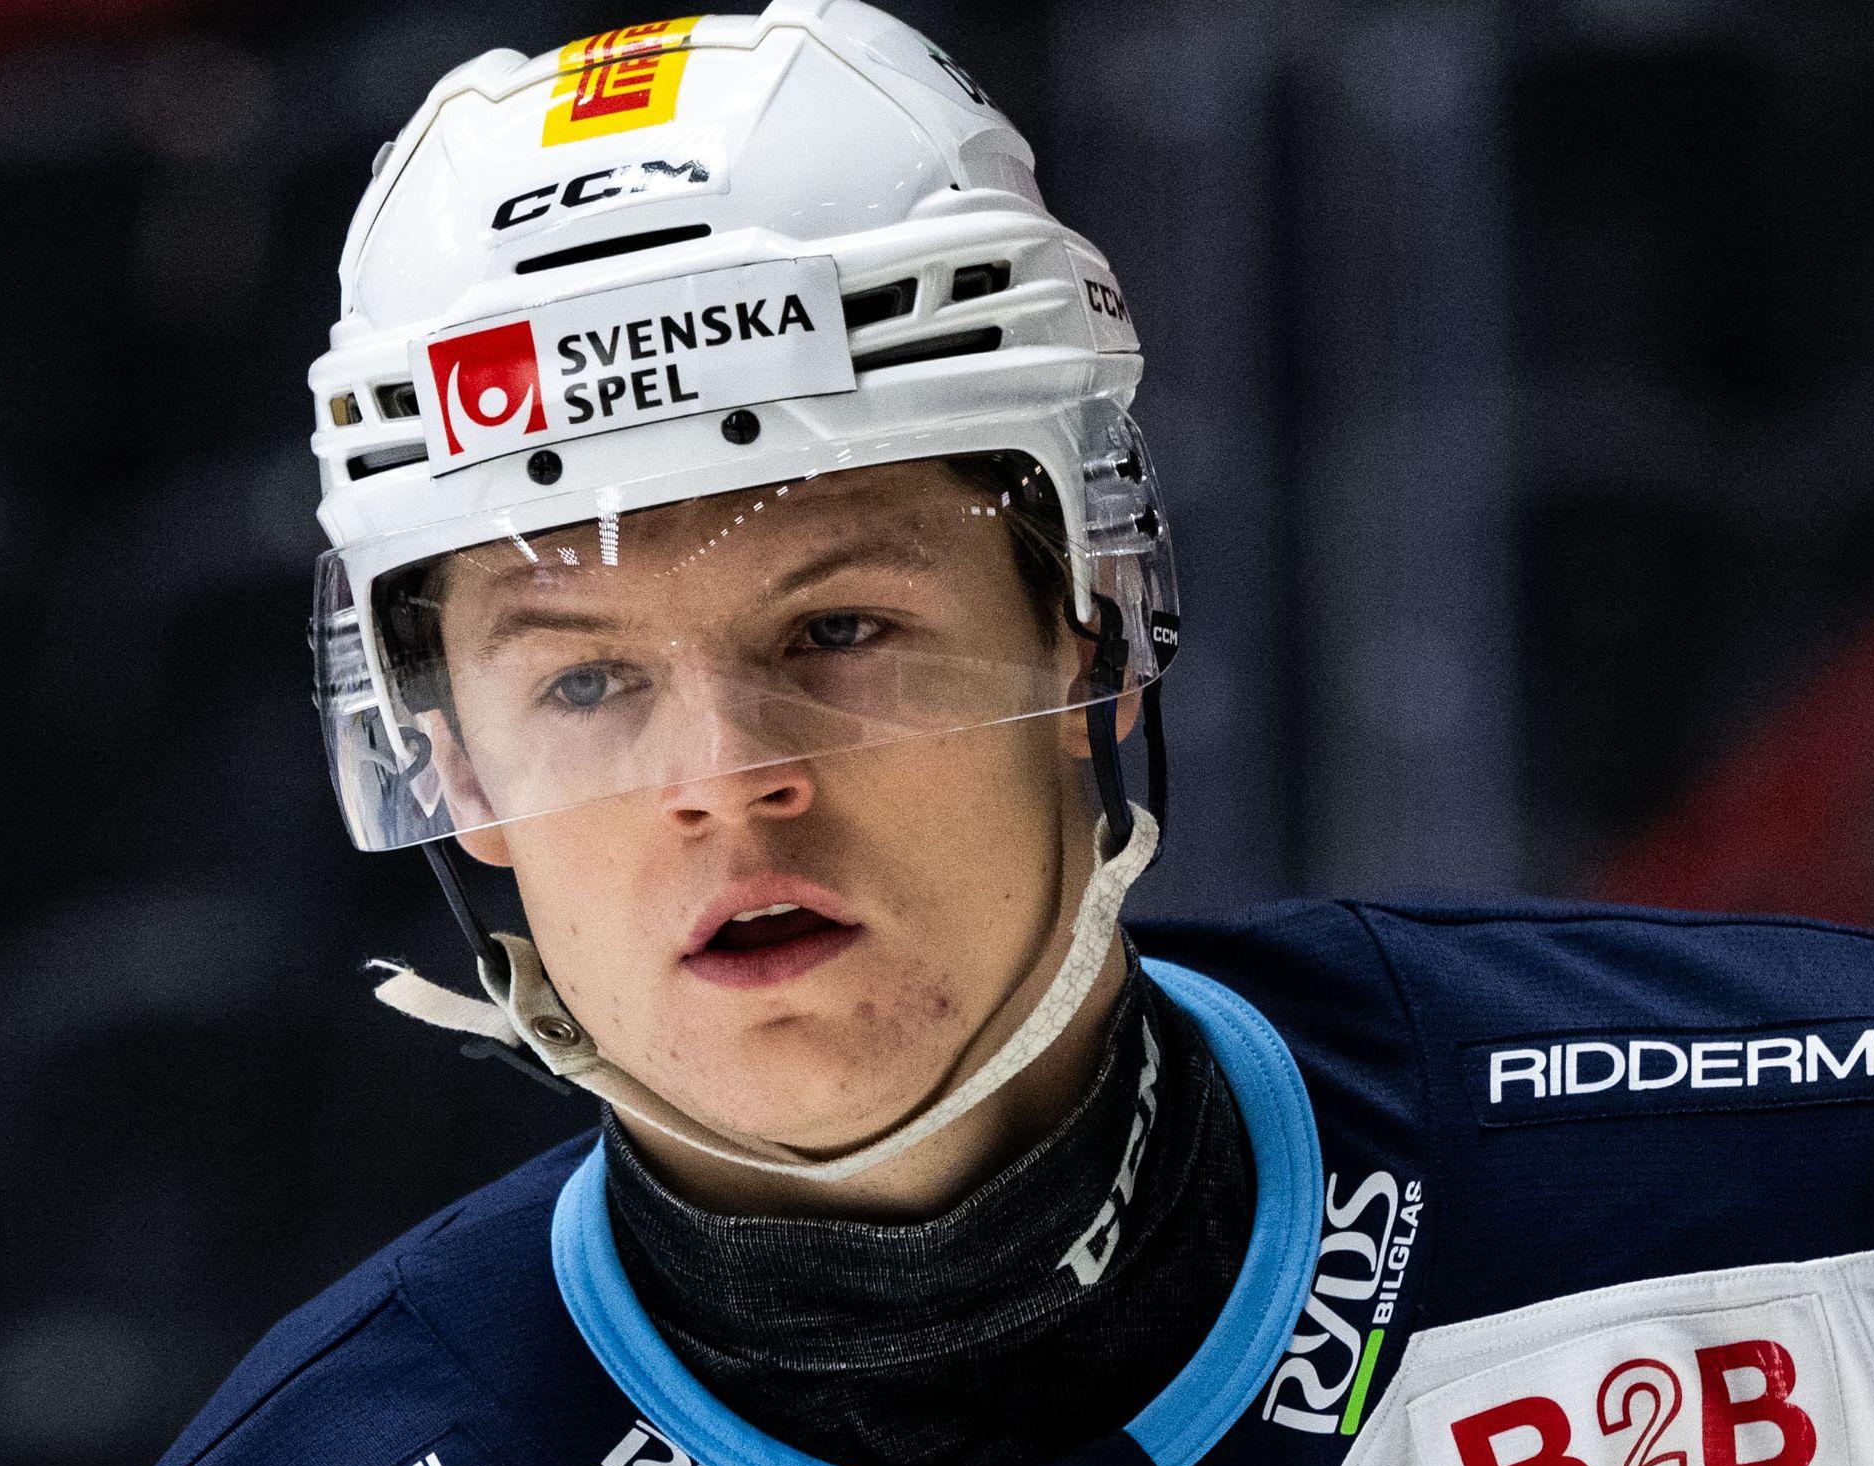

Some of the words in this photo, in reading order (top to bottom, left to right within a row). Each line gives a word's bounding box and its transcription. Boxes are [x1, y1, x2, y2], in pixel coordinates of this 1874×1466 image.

[557, 294, 815, 376] SVENSKA
[1083, 279, 1130, 324] CCM
[564, 364, 699, 424] SPEL
[1153, 626, 1178, 646] CCM
[1372, 1180, 1424, 1324] BILGLAS
[1262, 1171, 1398, 1434] RYDS
